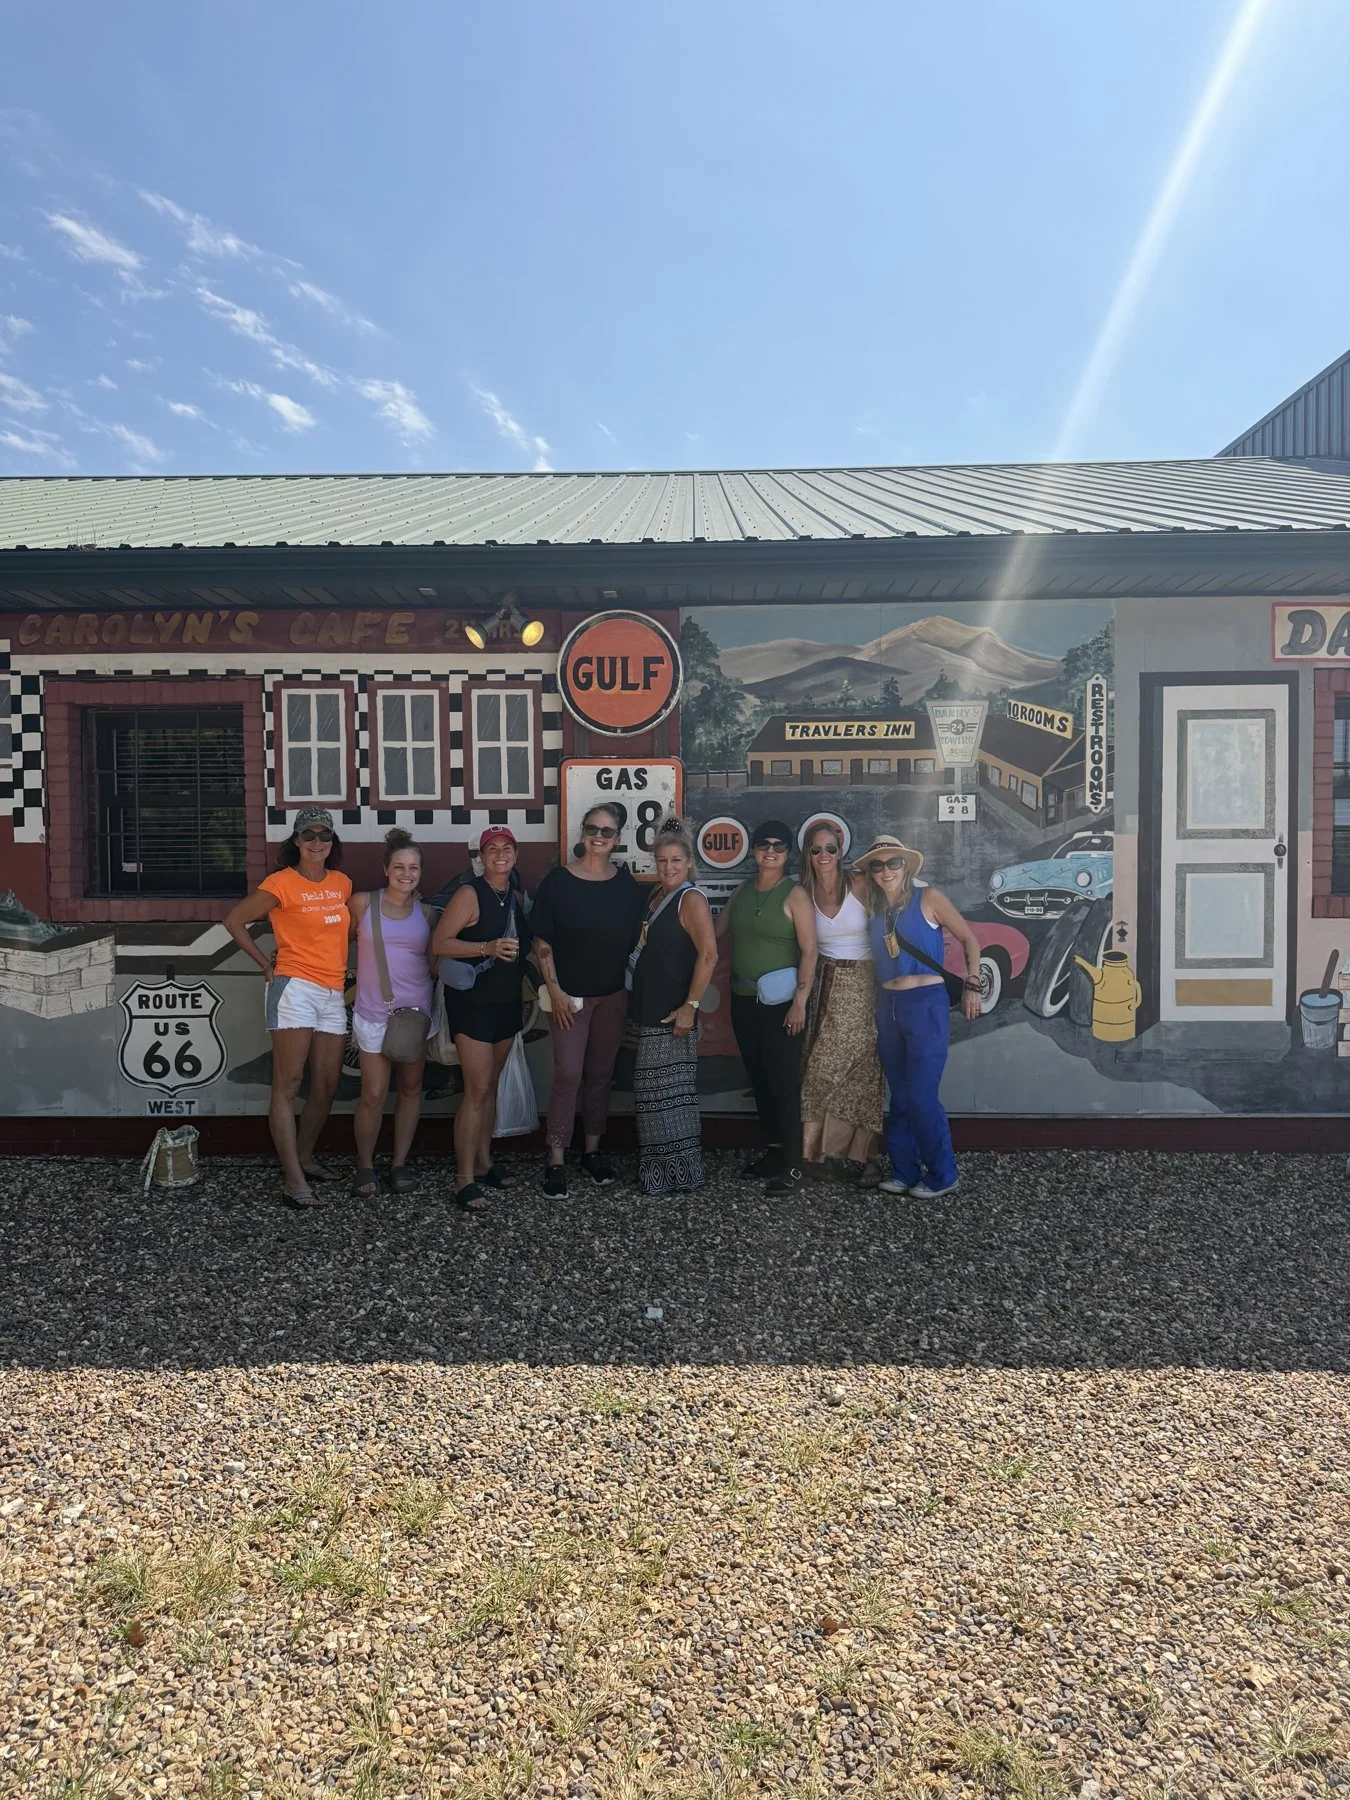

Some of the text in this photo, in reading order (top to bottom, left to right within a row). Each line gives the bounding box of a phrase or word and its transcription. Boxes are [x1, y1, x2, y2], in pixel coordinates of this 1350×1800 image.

[18, 611, 415, 646] CAROLYN'S CAFE
[572, 656, 665, 691] GULF
[951, 723, 964, 733] 24
[1020, 705, 1069, 733] ROOMS
[788, 723, 913, 738] TRAVLERS INN
[1089, 683, 1104, 806] RESTROOMS
[596, 767, 648, 791] GAS
[946, 796, 968, 804] GAS
[703, 833, 739, 851] GULF
[302, 890, 342, 901] Field Day
[138, 993, 203, 1009] ROUTE
[143, 1040, 202, 1079] 66
[148, 1100, 196, 1115] WEST
